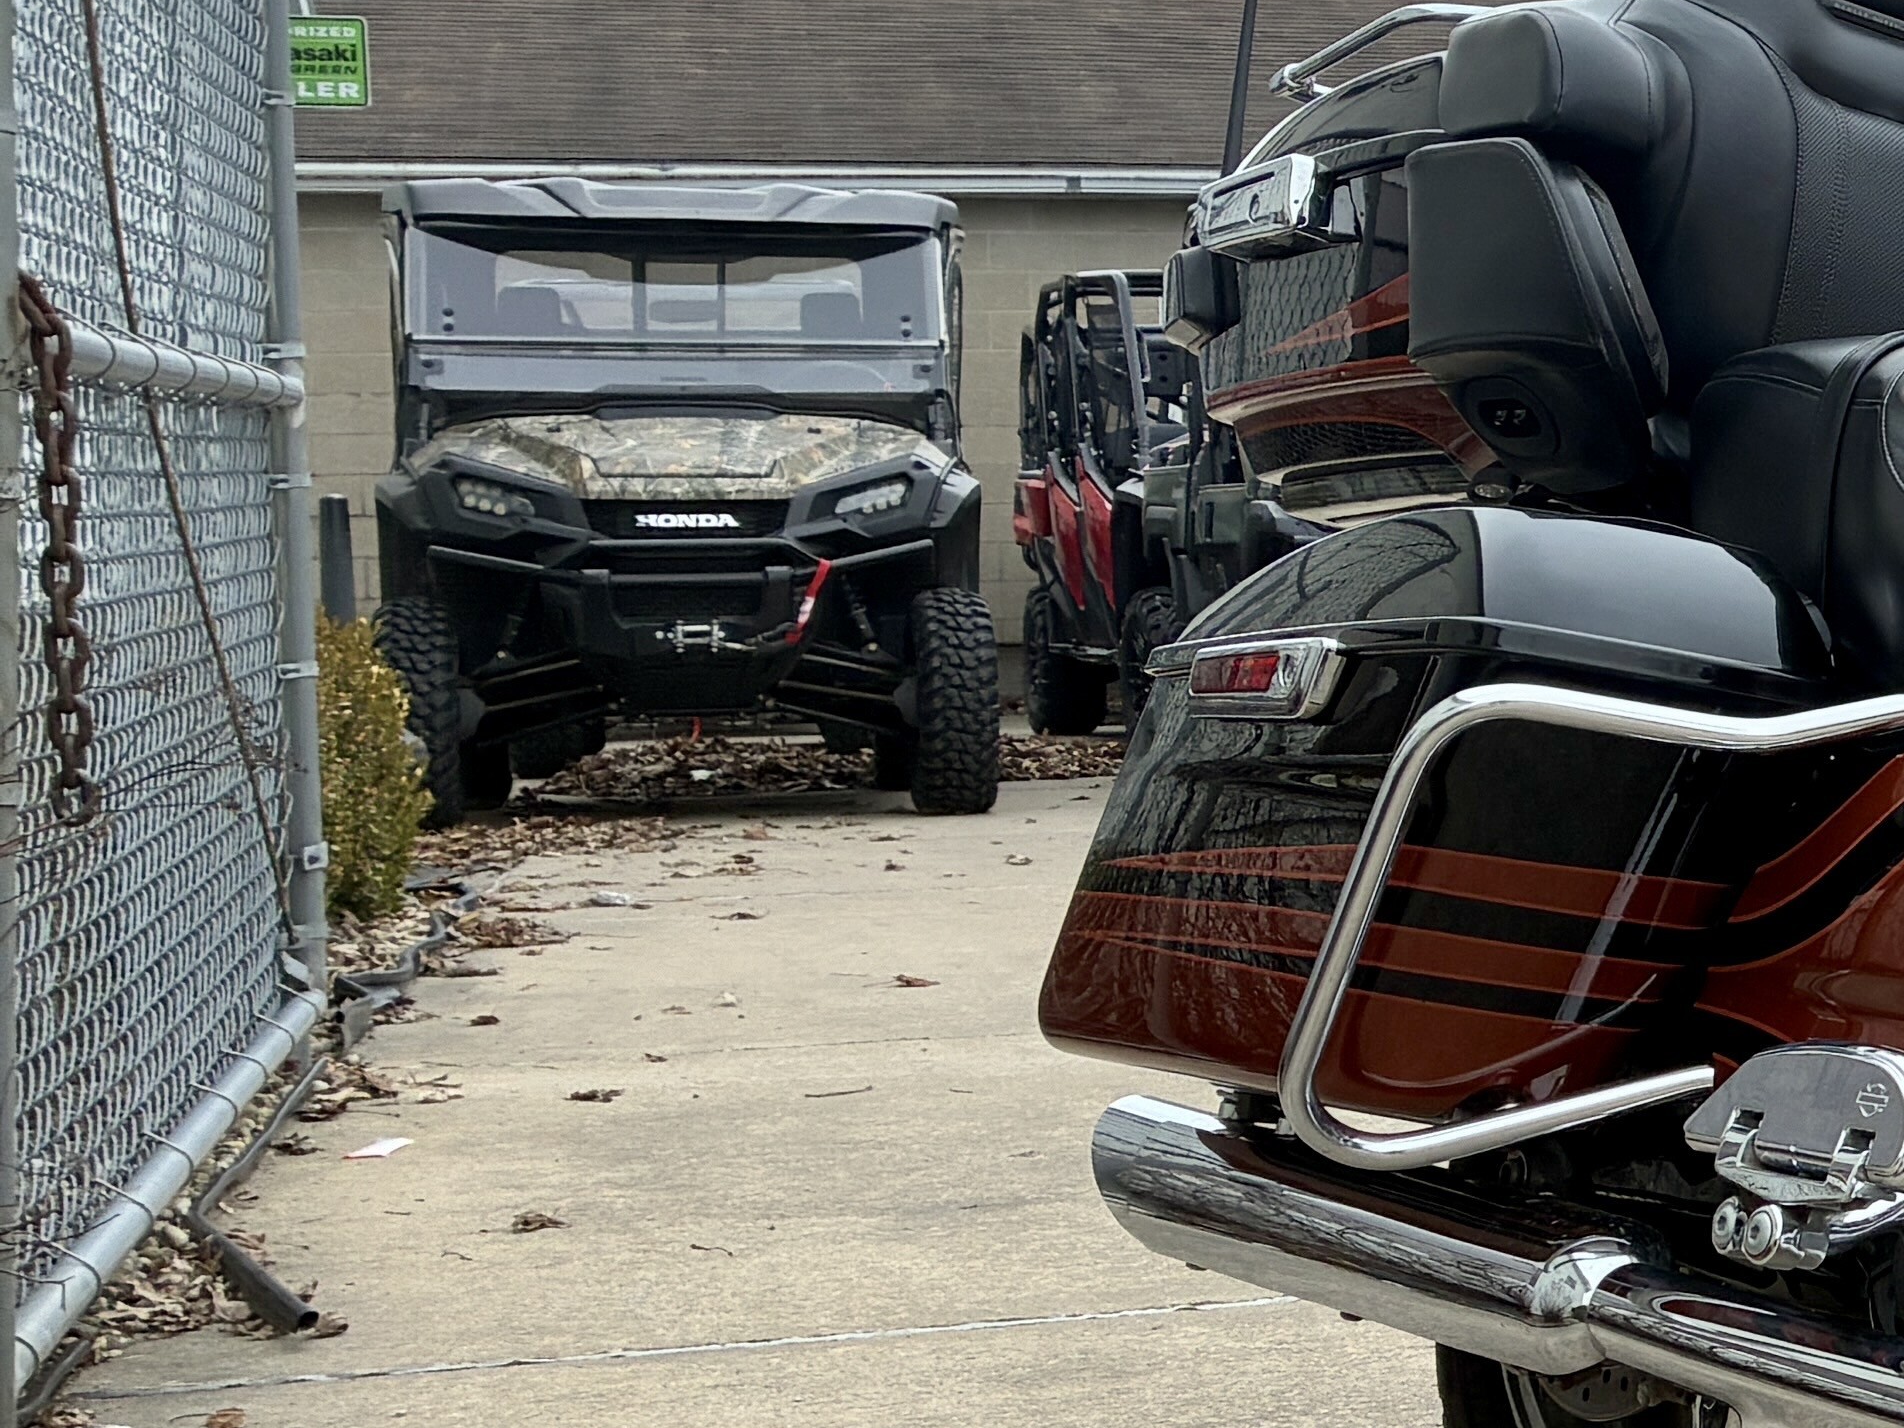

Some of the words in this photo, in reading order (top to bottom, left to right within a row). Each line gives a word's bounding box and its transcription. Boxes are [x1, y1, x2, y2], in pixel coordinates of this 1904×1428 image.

[288, 25, 356, 38] RIZED
[290, 43, 357, 62] asaki
[297, 81, 360, 98] LER
[634, 513, 742, 528] HONDA
